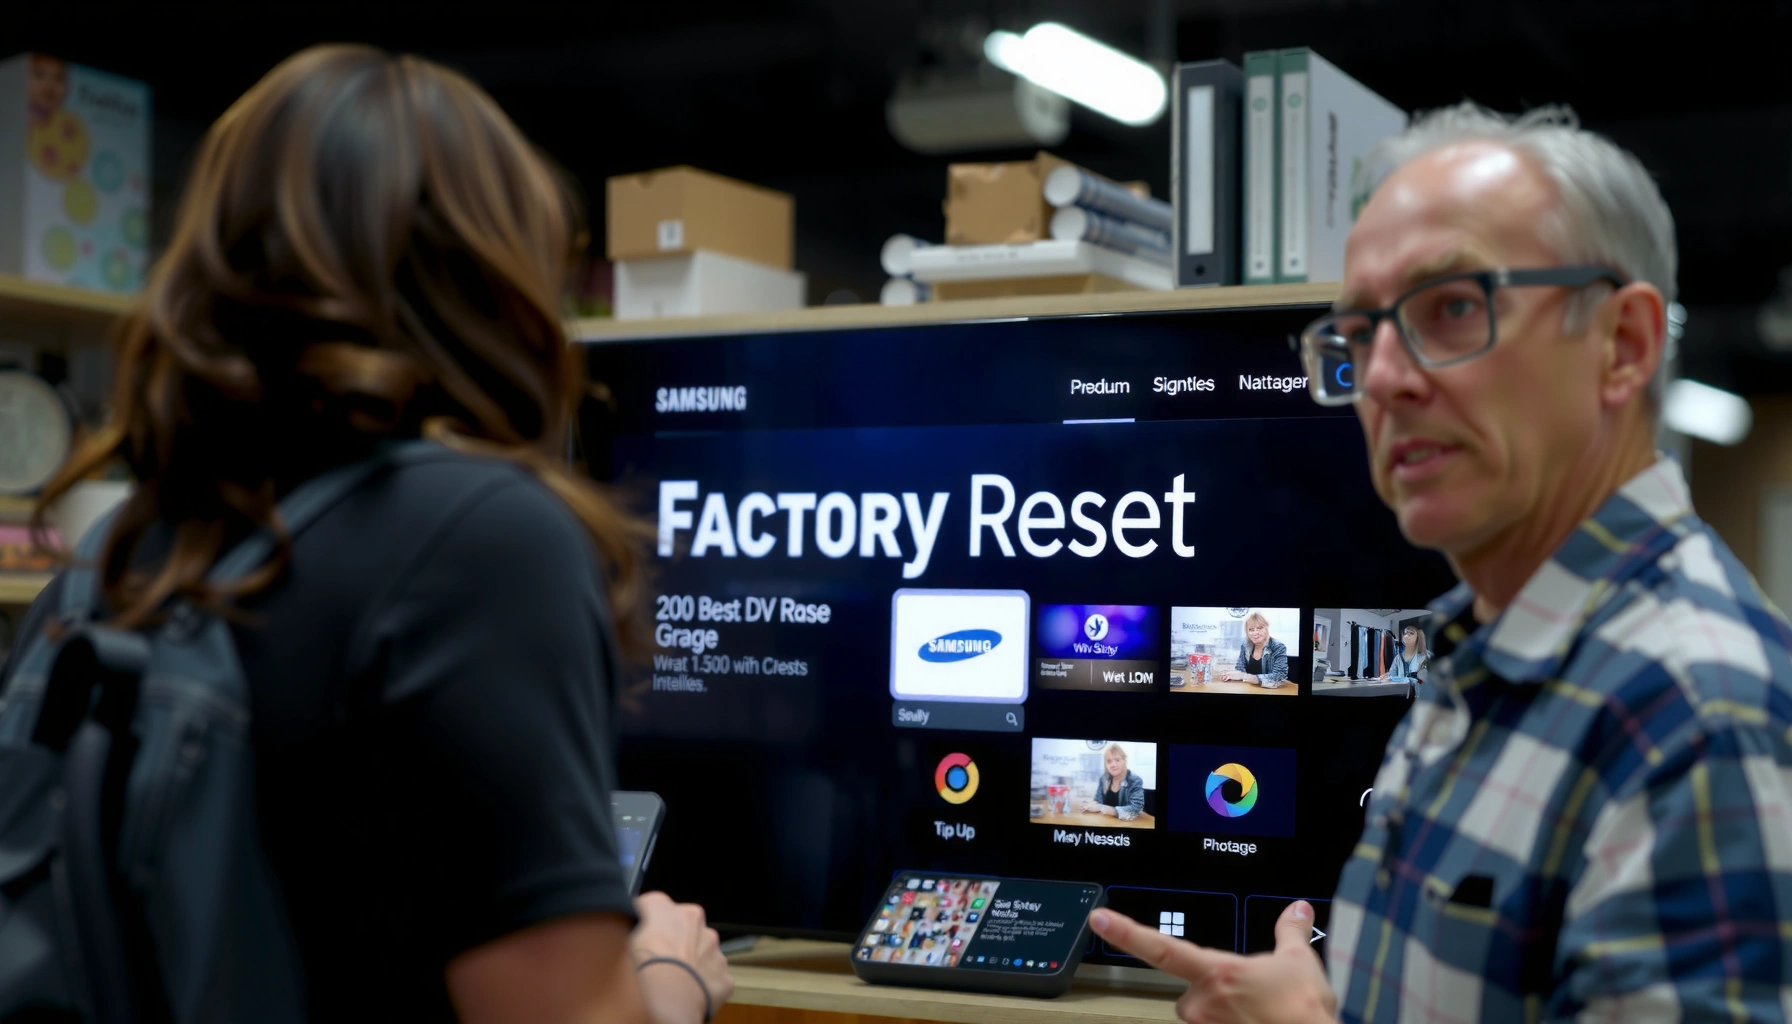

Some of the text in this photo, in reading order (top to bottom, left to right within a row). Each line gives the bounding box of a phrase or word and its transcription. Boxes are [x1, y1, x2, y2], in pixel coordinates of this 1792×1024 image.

[655, 385, 747, 413] SAMSUNG
[969, 473, 1197, 559] Reset
[655, 594, 695, 622] 200
[698, 595, 742, 623] Best
[744, 596, 777, 623] DV
[655, 622, 719, 655] Grage
[933, 820, 976, 842] Tip Up
